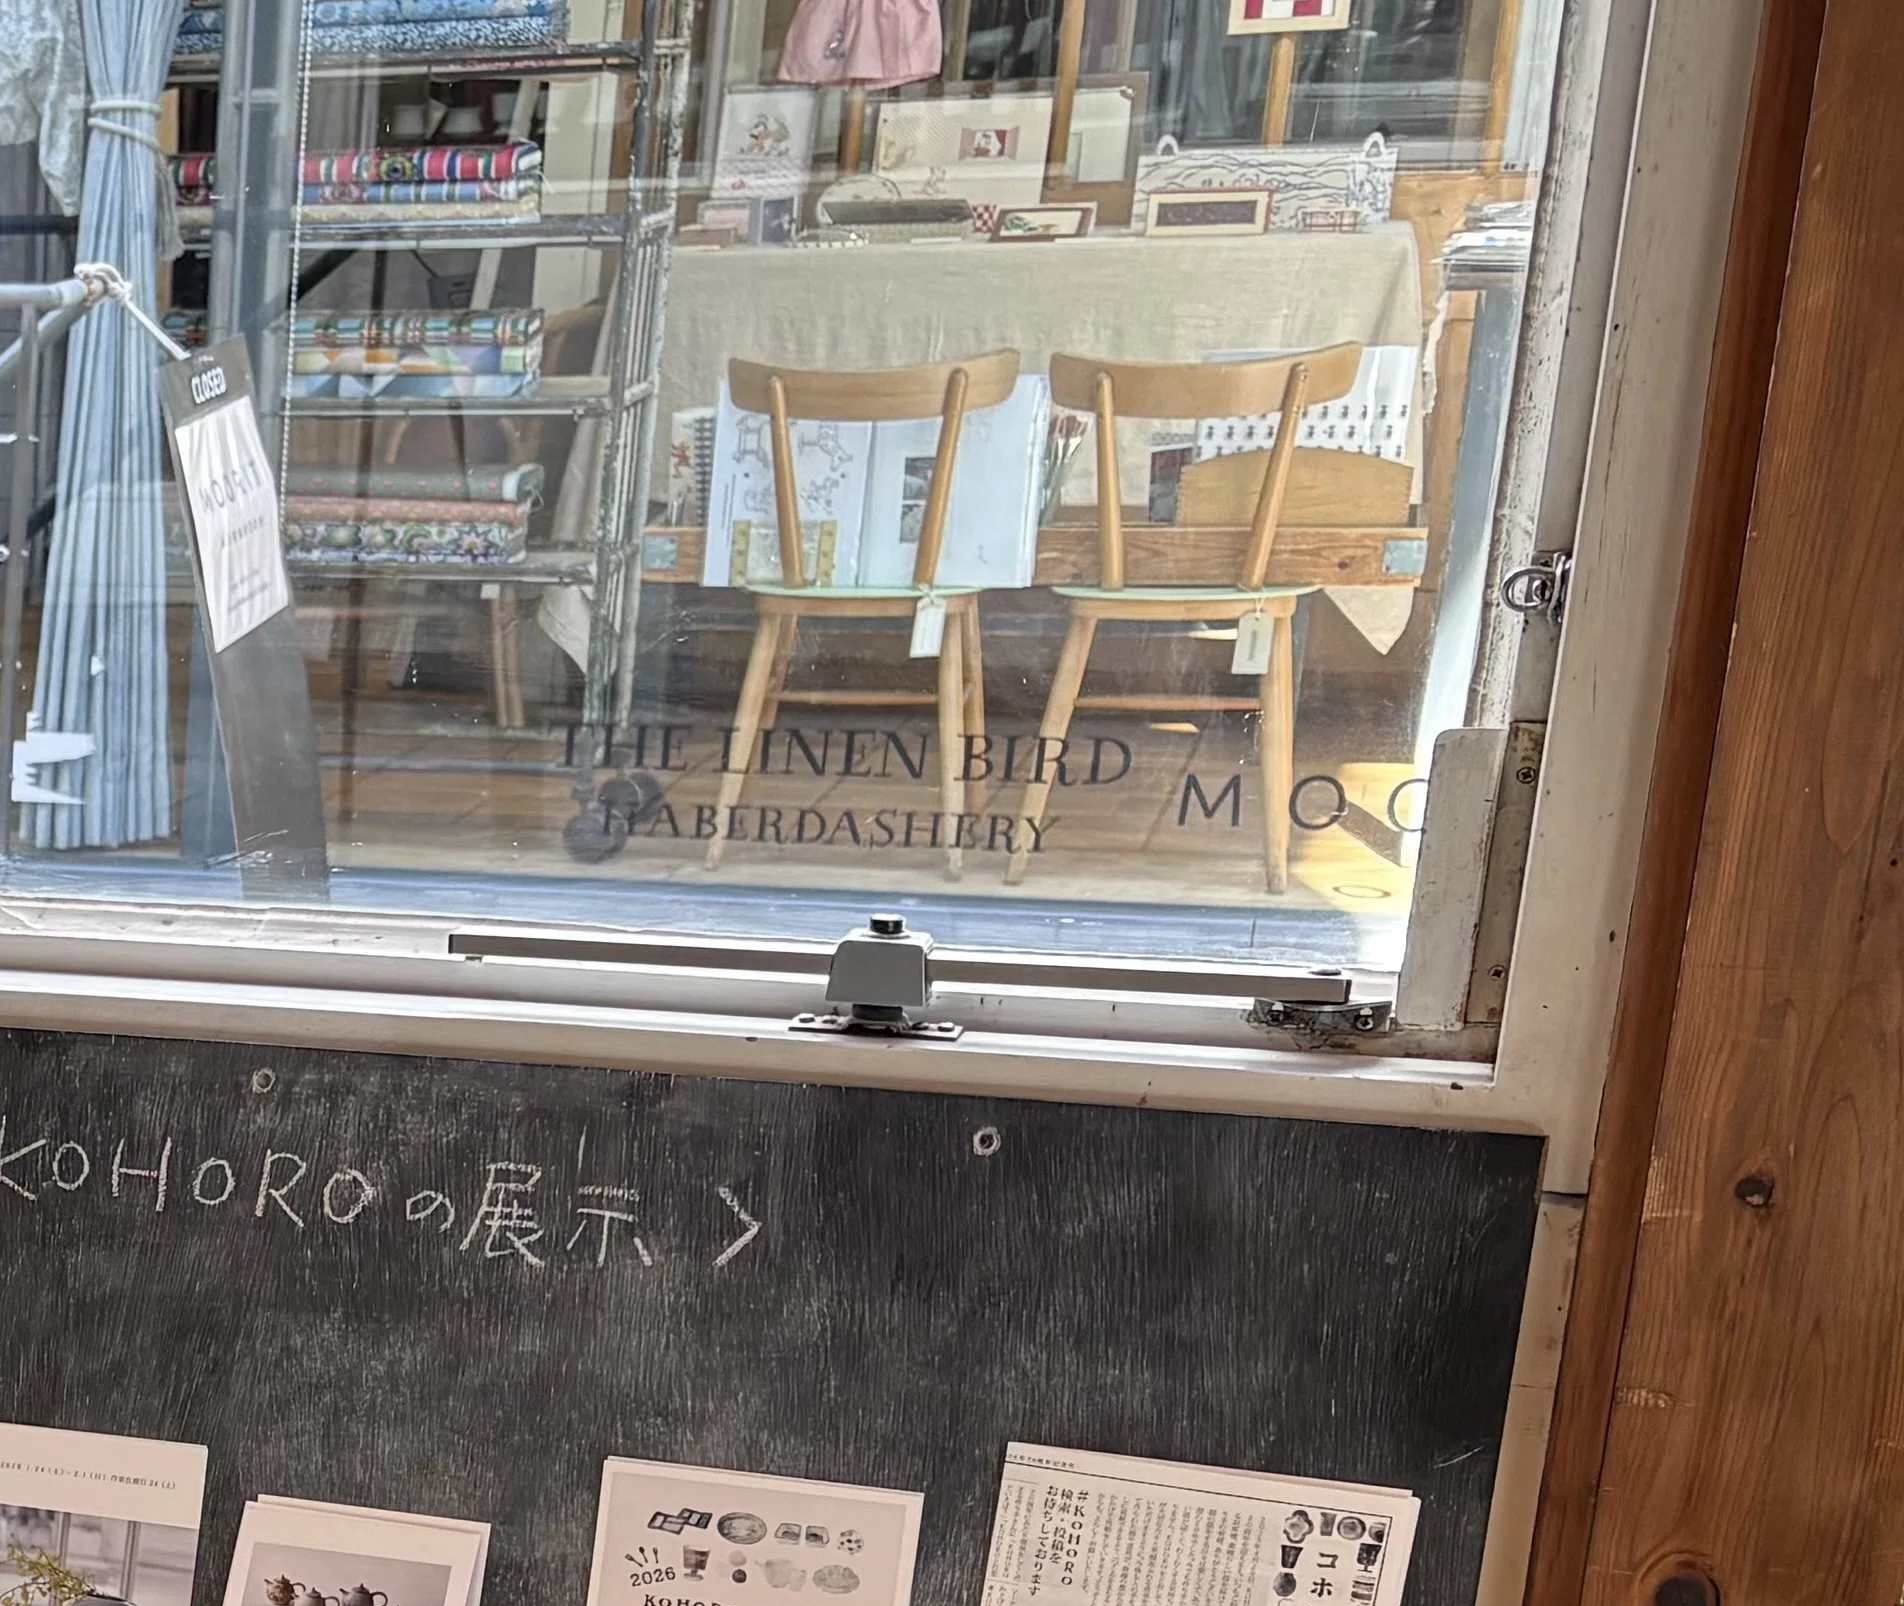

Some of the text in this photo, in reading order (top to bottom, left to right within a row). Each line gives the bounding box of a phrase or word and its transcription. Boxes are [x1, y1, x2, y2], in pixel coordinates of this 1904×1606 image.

[191, 366, 226, 404] CLOSED
[553, 723, 1131, 787] THE LINEN BIRD
[601, 799, 1061, 855] HABERDASHERY
[1028, 1485, 1059, 1597] お待ちしております
[1060, 1489, 1089, 1586] #KOHORO
[629, 1566, 677, 1588] 2026
